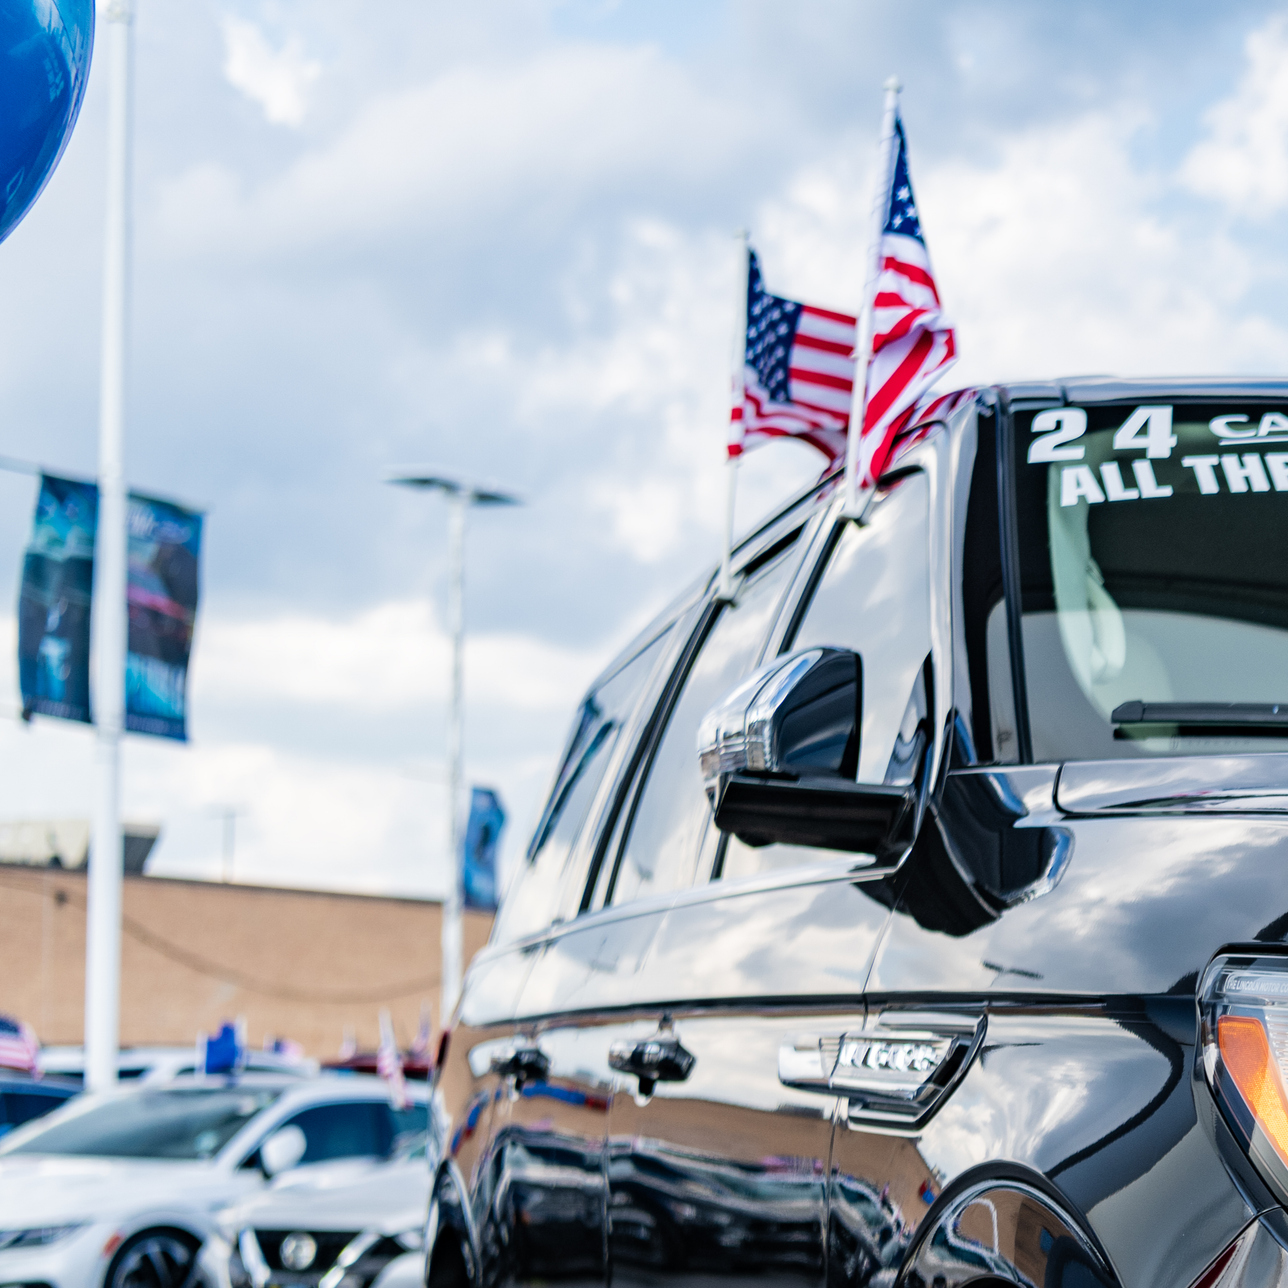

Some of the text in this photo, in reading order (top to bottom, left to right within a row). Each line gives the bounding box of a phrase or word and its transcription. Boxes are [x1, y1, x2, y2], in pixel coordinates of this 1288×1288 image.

[1060, 459, 1174, 507] ALL
[1236, 979, 1260, 992] LINCOLN
[1260, 982, 1280, 994] MOTOR
